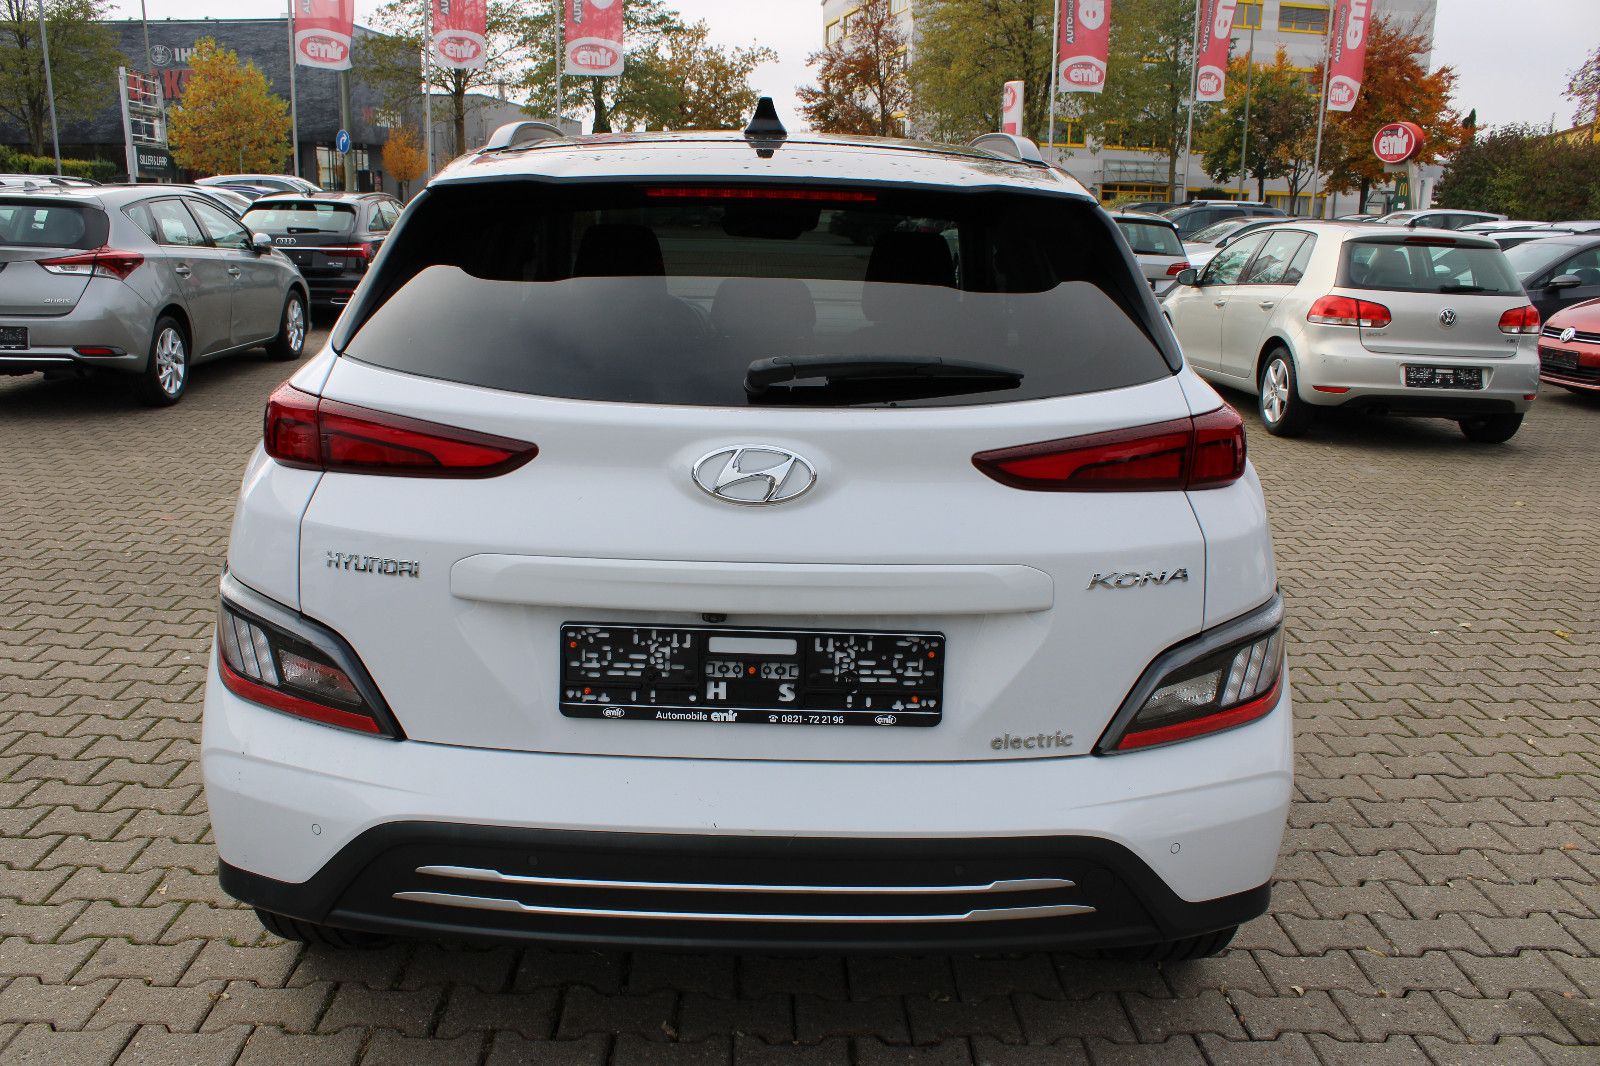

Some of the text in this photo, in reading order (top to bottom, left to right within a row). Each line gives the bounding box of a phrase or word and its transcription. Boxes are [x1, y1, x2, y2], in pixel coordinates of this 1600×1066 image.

[307, 41, 343, 60] emir
[445, 40, 476, 58] emir
[577, 48, 612, 67] emir
[1070, 65, 1100, 83] emir
[1379, 127, 1409, 155] emir
[326, 550, 420, 578] HYUNDAI
[1086, 568, 1189, 590] KONA
[605, 708, 623, 717] emir
[655, 709, 738, 722] Automobile emir
[990, 730, 1074, 751] electric
